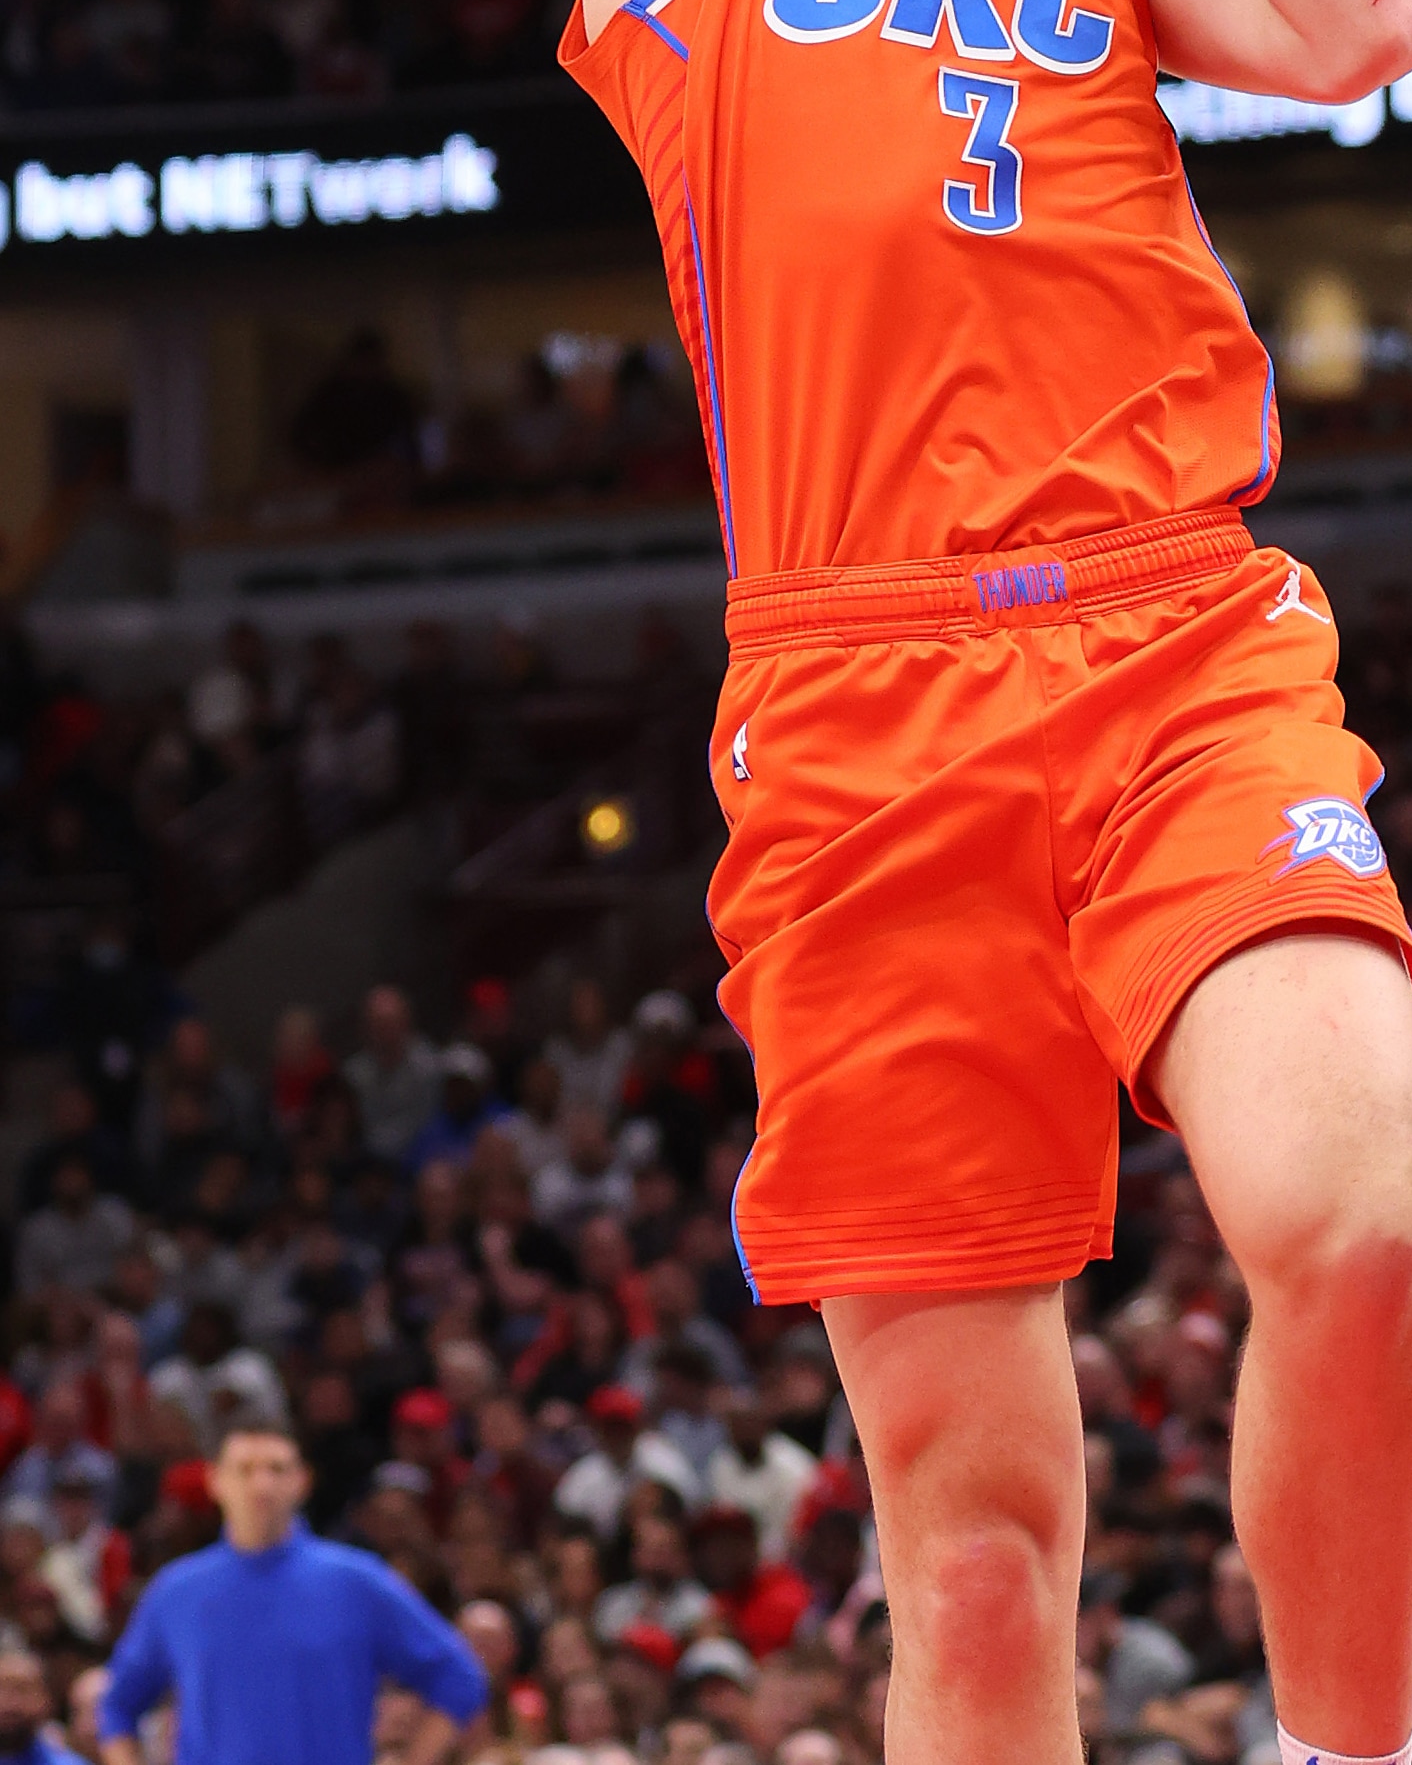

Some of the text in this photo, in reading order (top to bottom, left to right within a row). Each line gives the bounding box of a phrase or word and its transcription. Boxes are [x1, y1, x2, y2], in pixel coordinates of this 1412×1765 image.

[937, 65, 1023, 236] 3
[14, 161, 156, 242] but
[971, 560, 1069, 614] THUNDER
[1295, 817, 1373, 855] OKC
